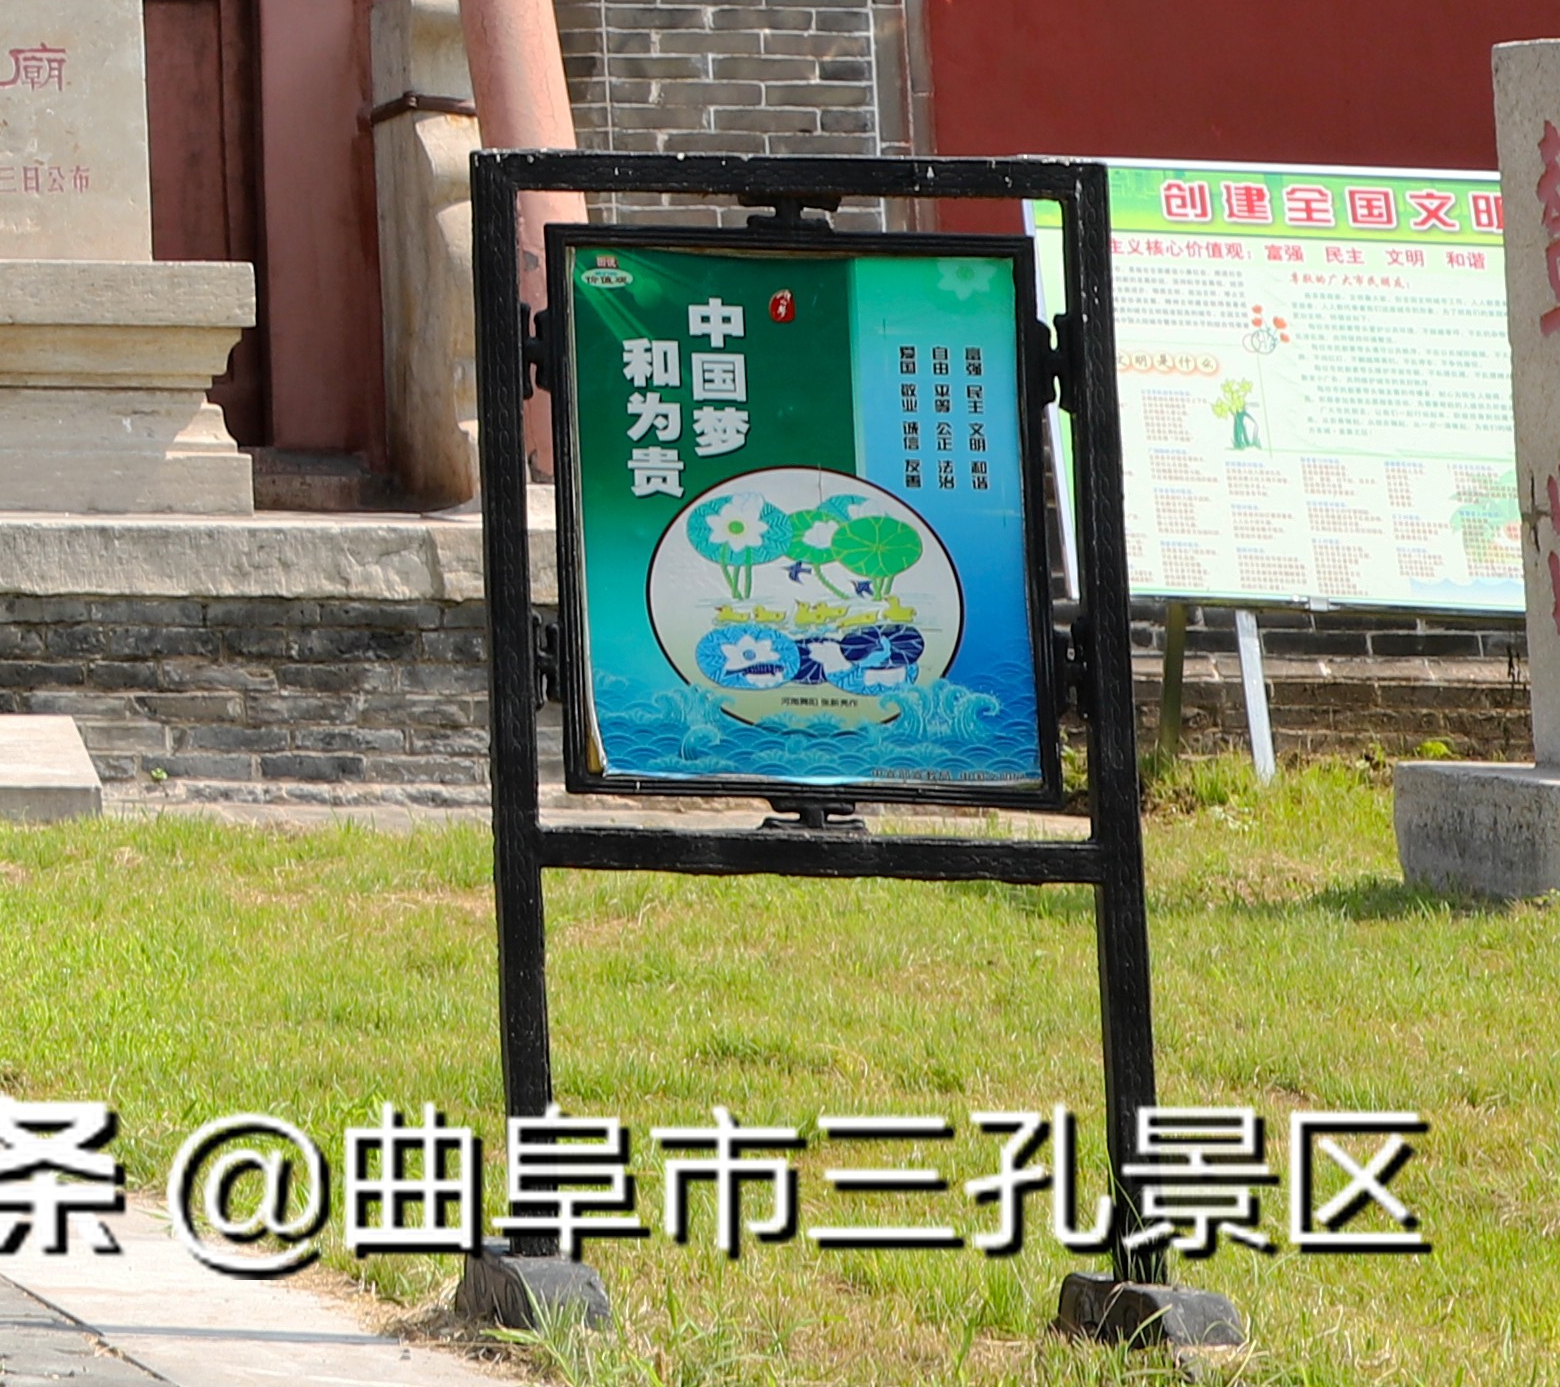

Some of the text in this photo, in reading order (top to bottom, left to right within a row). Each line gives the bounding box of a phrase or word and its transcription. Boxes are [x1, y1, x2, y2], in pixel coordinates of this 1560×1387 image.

[1265, 244, 1304, 263] 富强
[1325, 246, 1365, 265] 民主
[1386, 248, 1425, 268] 文明
[1446, 250, 1486, 270] 和谐
[621, 337, 686, 500] 和为贵
[687, 297, 751, 460] 中国梦
[932, 346, 955, 489] 自由 平等 公正 法治
[967, 384, 984, 414] 民主
[968, 423, 986, 452] 文明
